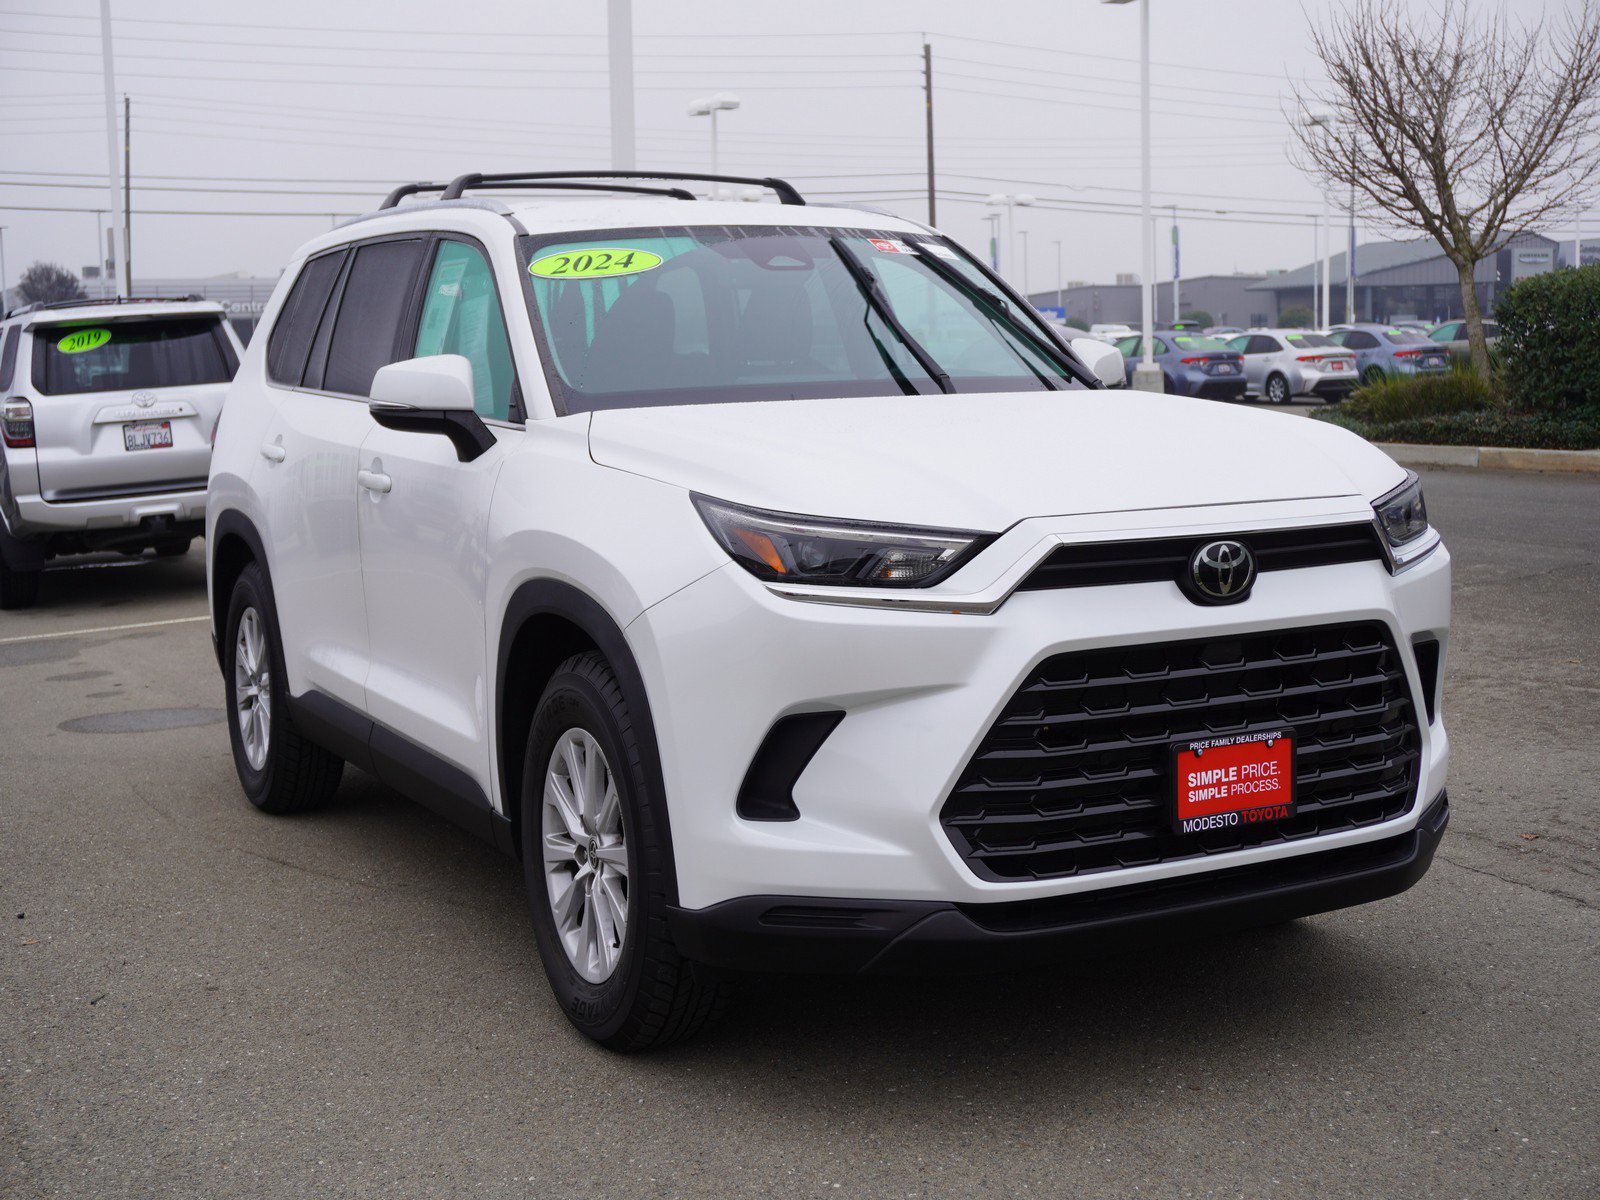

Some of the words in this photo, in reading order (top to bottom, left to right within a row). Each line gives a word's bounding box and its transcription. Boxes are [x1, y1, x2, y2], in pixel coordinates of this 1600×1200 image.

[550, 252, 636, 275] 2024
[68, 330, 101, 351] 2019
[1190, 741, 1209, 750] PRICE
[1211, 737, 1235, 748] FAMILY
[1236, 731, 1282, 743] DEALERSHIPS
[1188, 767, 1237, 787] SIMPLE
[1241, 761, 1281, 779] PRICE.
[1188, 786, 1228, 802] SIMPLE
[1231, 778, 1281, 795] PROCESS.
[1183, 813, 1238, 833] MODESTO
[1242, 806, 1288, 823] TOYOTA
